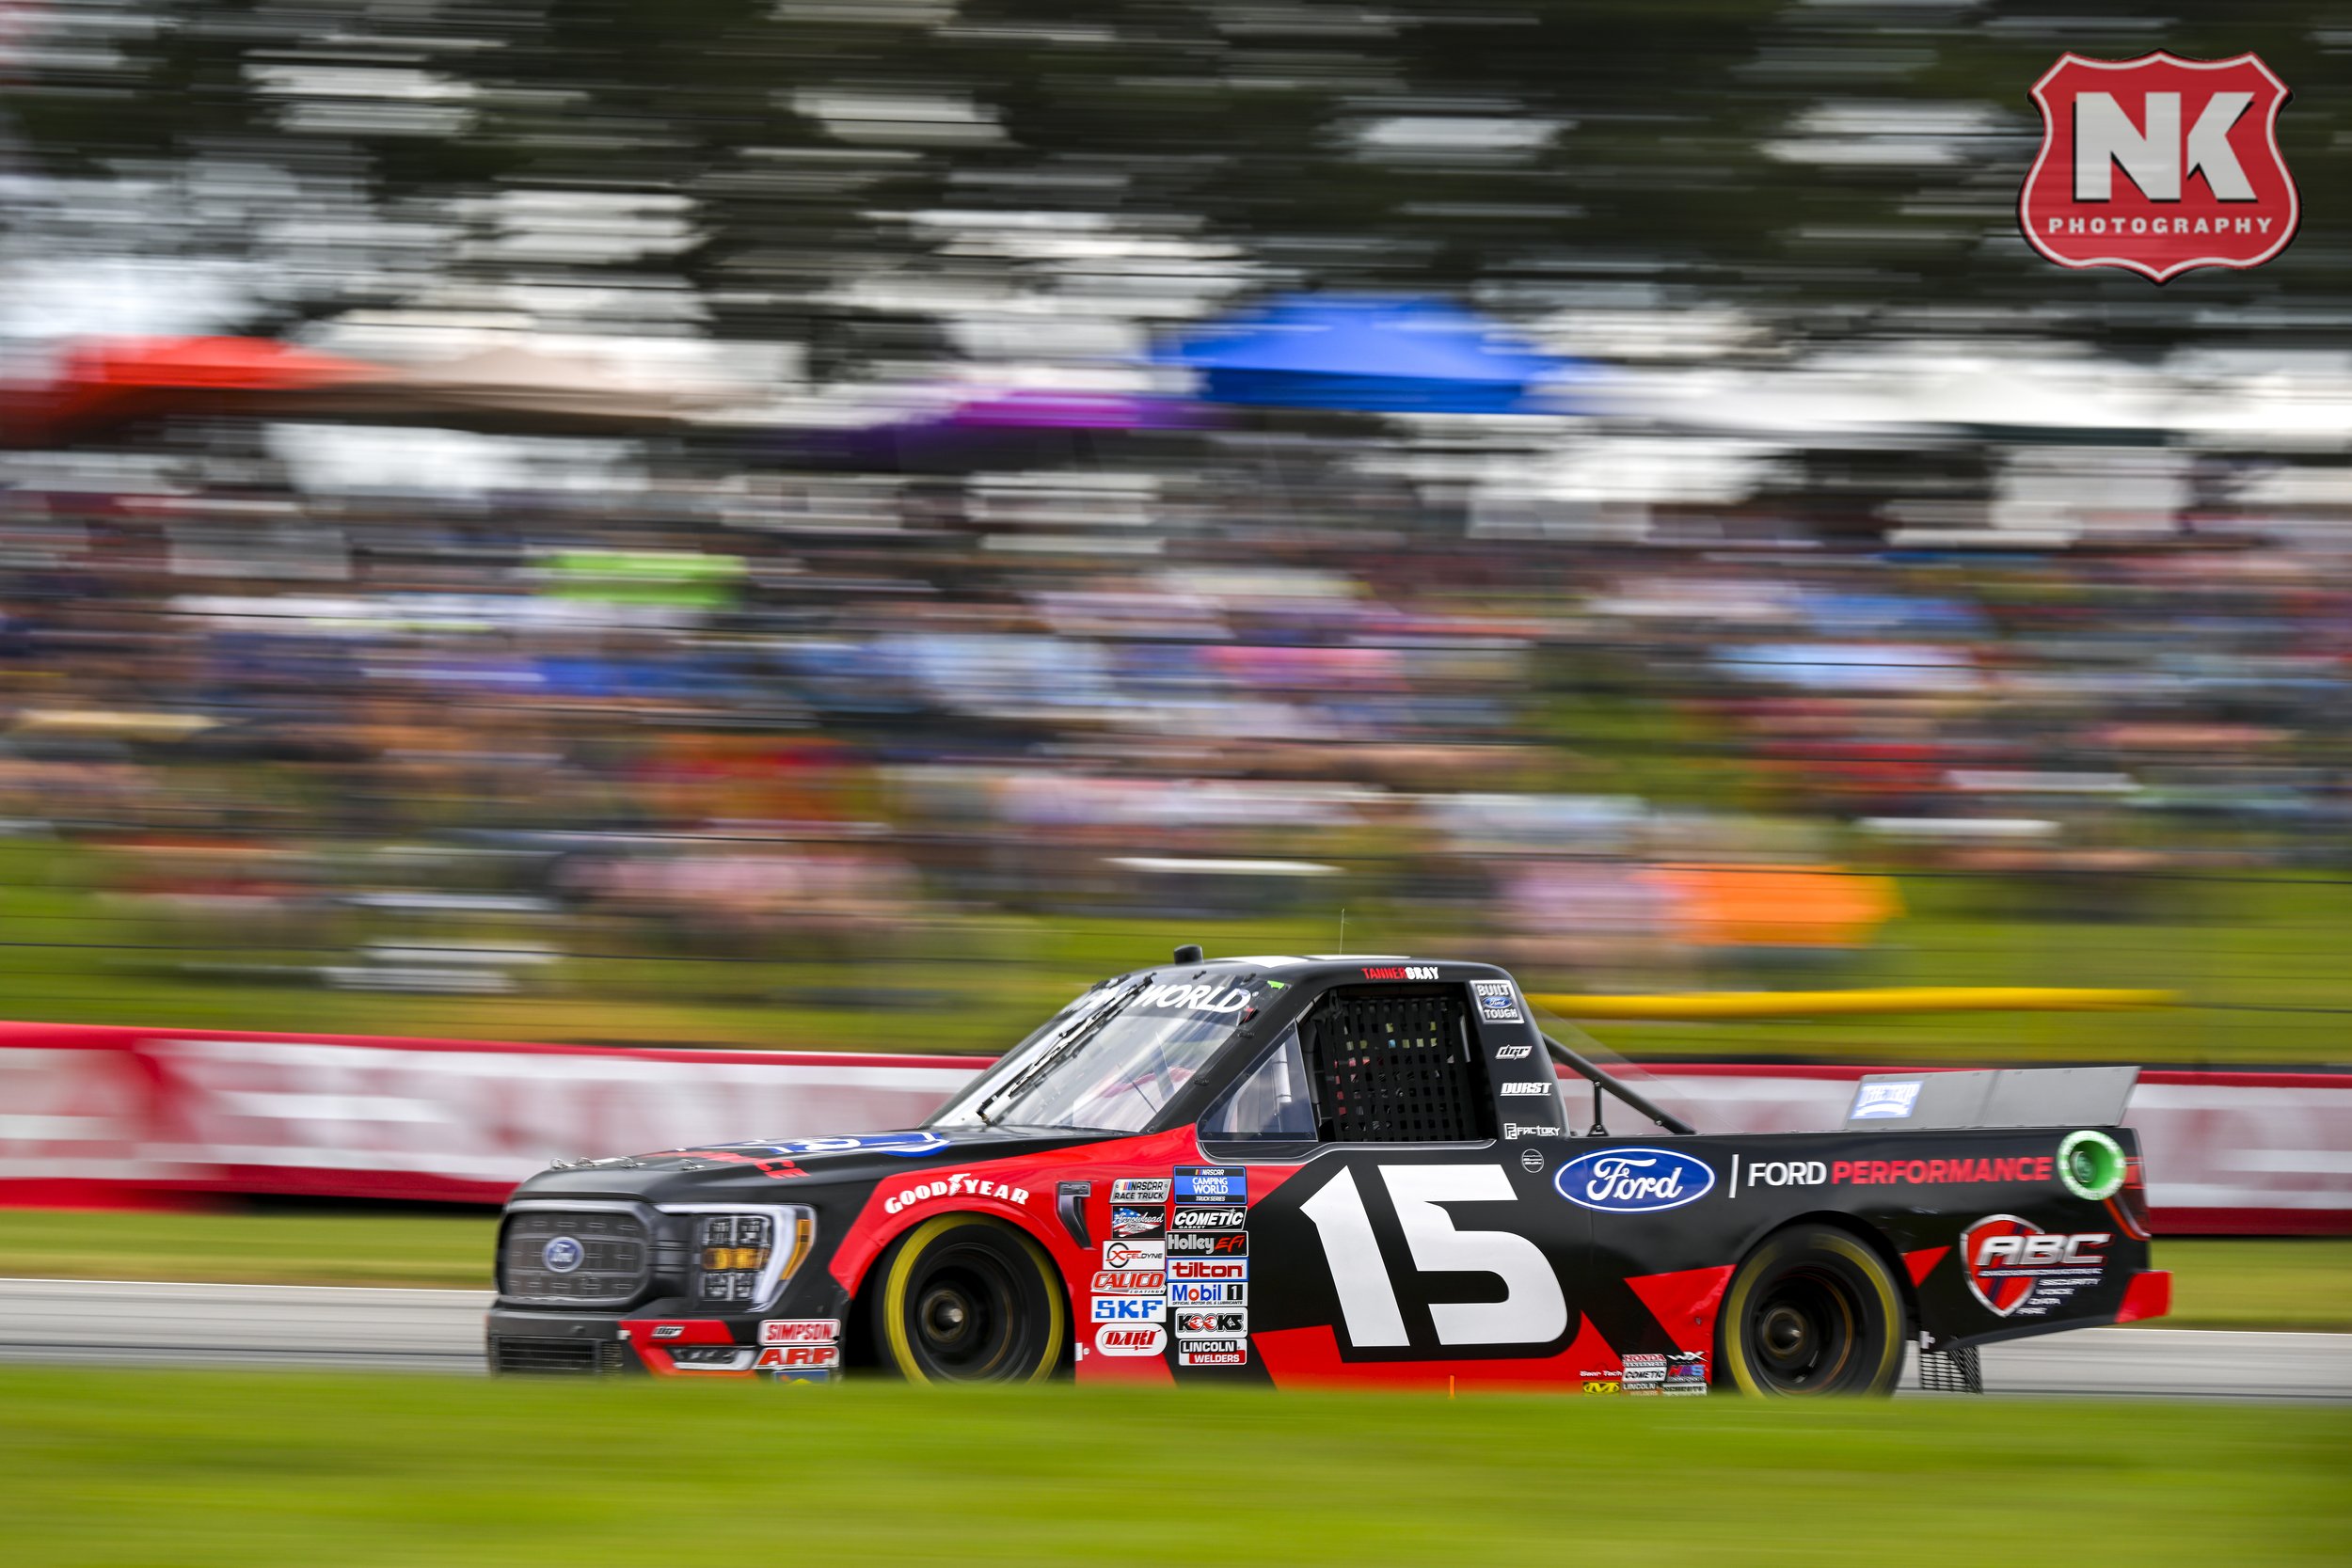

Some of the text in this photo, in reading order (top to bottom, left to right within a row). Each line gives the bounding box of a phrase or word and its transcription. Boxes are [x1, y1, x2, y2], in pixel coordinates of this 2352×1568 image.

[1477, 984, 1510, 996] BUILT
[1131, 984, 1252, 1014] WORLD
[1484, 1008, 1518, 1019] TOUGH
[1500, 1082, 1552, 1096] DURST
[1585, 1157, 1684, 1200] Ford
[1747, 1162, 1828, 1187] FORD
[1831, 1156, 2053, 1185] PERFORMANCE
[1131, 1181, 1164, 1191] NASCAR
[1192, 1177, 1228, 1185] CAMPING
[884, 1176, 1030, 1214] GOODYEAR
[1194, 1185, 1229, 1195] WORLD
[1112, 1212, 1165, 1225] Arrowhead
[1174, 1212, 1244, 1226] COMETIC
[1168, 1234, 1215, 1255] Holley
[1975, 1233, 2112, 1266] ABC
[1105, 1250, 1163, 1262] XCELDYNE
[1298, 1164, 1568, 1347] 15
[1172, 1261, 1244, 1278] tilton
[1093, 1272, 1166, 1290] CALICO
[1172, 1284, 1239, 1302] Mobil 1
[1095, 1300, 1164, 1319] SKF
[1177, 1312, 1245, 1333] KOOKS
[767, 1323, 834, 1340] SIMPSON
[1105, 1328, 1162, 1346] DART
[1182, 1341, 1235, 1353] LINCOLN
[757, 1347, 836, 1366] ARP
[1194, 1354, 1240, 1363] WELDERS
[1625, 1370, 1665, 1382] COMETIC
[1623, 1382, 1656, 1390] LINCOLN
